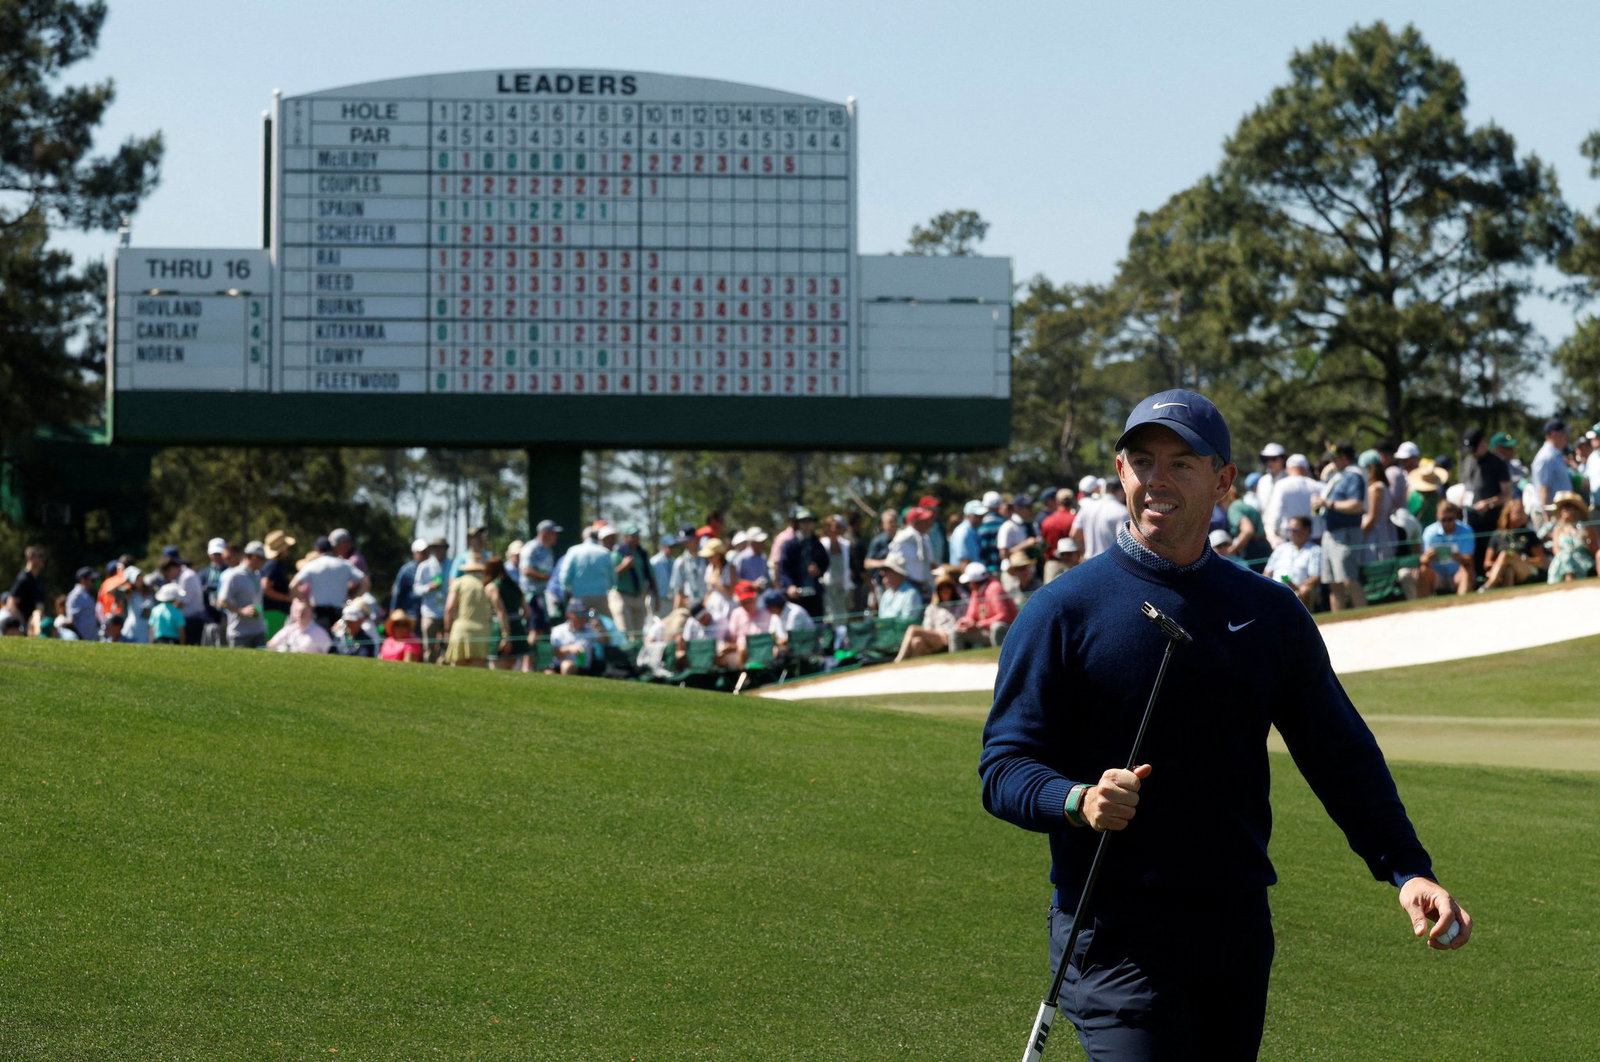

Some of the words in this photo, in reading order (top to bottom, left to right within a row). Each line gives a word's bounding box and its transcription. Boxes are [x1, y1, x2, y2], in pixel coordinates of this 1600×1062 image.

[497, 74, 637, 95] LEADERS
[342, 104, 398, 119] HOLE
[462, 104, 472, 121] 2
[486, 104, 496, 121] 3
[508, 104, 518, 121] 4
[530, 105, 540, 121] 5
[553, 105, 563, 122] 6
[576, 104, 586, 121] 7
[598, 106, 608, 122] 8
[623, 106, 633, 122] 9
[648, 107, 662, 124] 10
[672, 107, 684, 124] 11
[692, 108, 706, 124] 12
[716, 108, 730, 124] 13
[738, 108, 752, 125] 14
[760, 108, 774, 125] 15
[784, 109, 798, 125] 16
[806, 109, 820, 125] 17
[829, 110, 843, 126] 18
[350, 128, 390, 143] PAR
[438, 128, 448, 144] 4
[462, 128, 472, 145] 5
[484, 128, 494, 145] 4
[508, 128, 518, 145] 3
[530, 129, 540, 145] 4
[553, 129, 563, 146] 3
[576, 129, 586, 146] 4
[598, 130, 608, 146] 5
[622, 130, 632, 146] 4
[648, 131, 658, 147] 4
[672, 131, 682, 148] 4
[694, 132, 704, 148] 3
[718, 131, 728, 148] 5
[738, 132, 748, 148] 4
[762, 132, 772, 149] 5
[784, 133, 794, 149] 3
[807, 133, 817, 149] 4
[830, 133, 840, 150] 4
[439, 152, 449, 168] 0
[484, 152, 494, 169] 0
[507, 153, 517, 169] 0
[530, 152, 540, 169] 0
[553, 153, 563, 169] 0
[576, 153, 586, 170] 0
[622, 154, 632, 171] 2
[649, 155, 659, 172] 2
[672, 155, 682, 172] 2
[694, 155, 704, 172] 2
[740, 156, 750, 172] 4
[318, 176, 381, 192] COUPLES
[462, 176, 472, 193] 2
[484, 176, 494, 193] 2
[508, 176, 518, 193] 2
[530, 177, 540, 194] 2
[552, 177, 562, 194] 2
[576, 177, 586, 194] 2
[598, 177, 608, 194] 2
[622, 177, 632, 194] 2
[318, 200, 364, 216] SPAUN
[530, 202, 540, 219] 2
[553, 201, 563, 218] 2
[576, 202, 586, 219] 2
[317, 225, 396, 241] SCHEFFLER
[462, 225, 472, 242] 2
[316, 249, 340, 265] RAI
[462, 250, 472, 266] 2
[484, 250, 494, 267] 2
[146, 259, 211, 279] THRU
[225, 259, 250, 279] 16
[316, 274, 354, 290] REED
[648, 276, 658, 292] 4
[671, 276, 681, 292] 4
[694, 276, 704, 293] 4
[716, 277, 726, 293] 4
[739, 277, 749, 293] 4
[137, 301, 202, 317] HOVLAND
[250, 302, 260, 317] 3
[316, 299, 364, 315] BURNS
[437, 299, 447, 316] 0
[460, 299, 470, 316] 2
[483, 299, 493, 316] 2
[506, 299, 516, 316] 2
[529, 300, 539, 316] 2
[598, 300, 608, 317] 2
[620, 300, 630, 318] 2
[648, 300, 658, 317] 2
[670, 300, 680, 317] 2
[716, 301, 726, 318] 4
[739, 301, 749, 318] 4
[137, 322, 198, 339] CANTLAY
[250, 324, 260, 340] 4
[316, 324, 386, 340] KITAYAMA
[437, 324, 447, 340] 0
[529, 324, 539, 341] 0
[574, 325, 584, 342] 2
[598, 325, 608, 342] 2
[648, 325, 658, 341] 4
[716, 326, 726, 343] 2
[137, 346, 184, 362] NOREN
[250, 346, 260, 362] 5
[316, 348, 364, 364] LOWRY
[460, 349, 470, 366] 2
[483, 349, 493, 366] 2
[506, 349, 516, 366] 0
[528, 350, 538, 366] 0
[597, 350, 607, 366] 0
[316, 372, 399, 388] FLEETWOOD
[436, 374, 446, 390] 0
[483, 374, 493, 391] 2
[620, 375, 630, 392] 4
[716, 375, 726, 392] 2
[808, 376, 818, 393] 2
